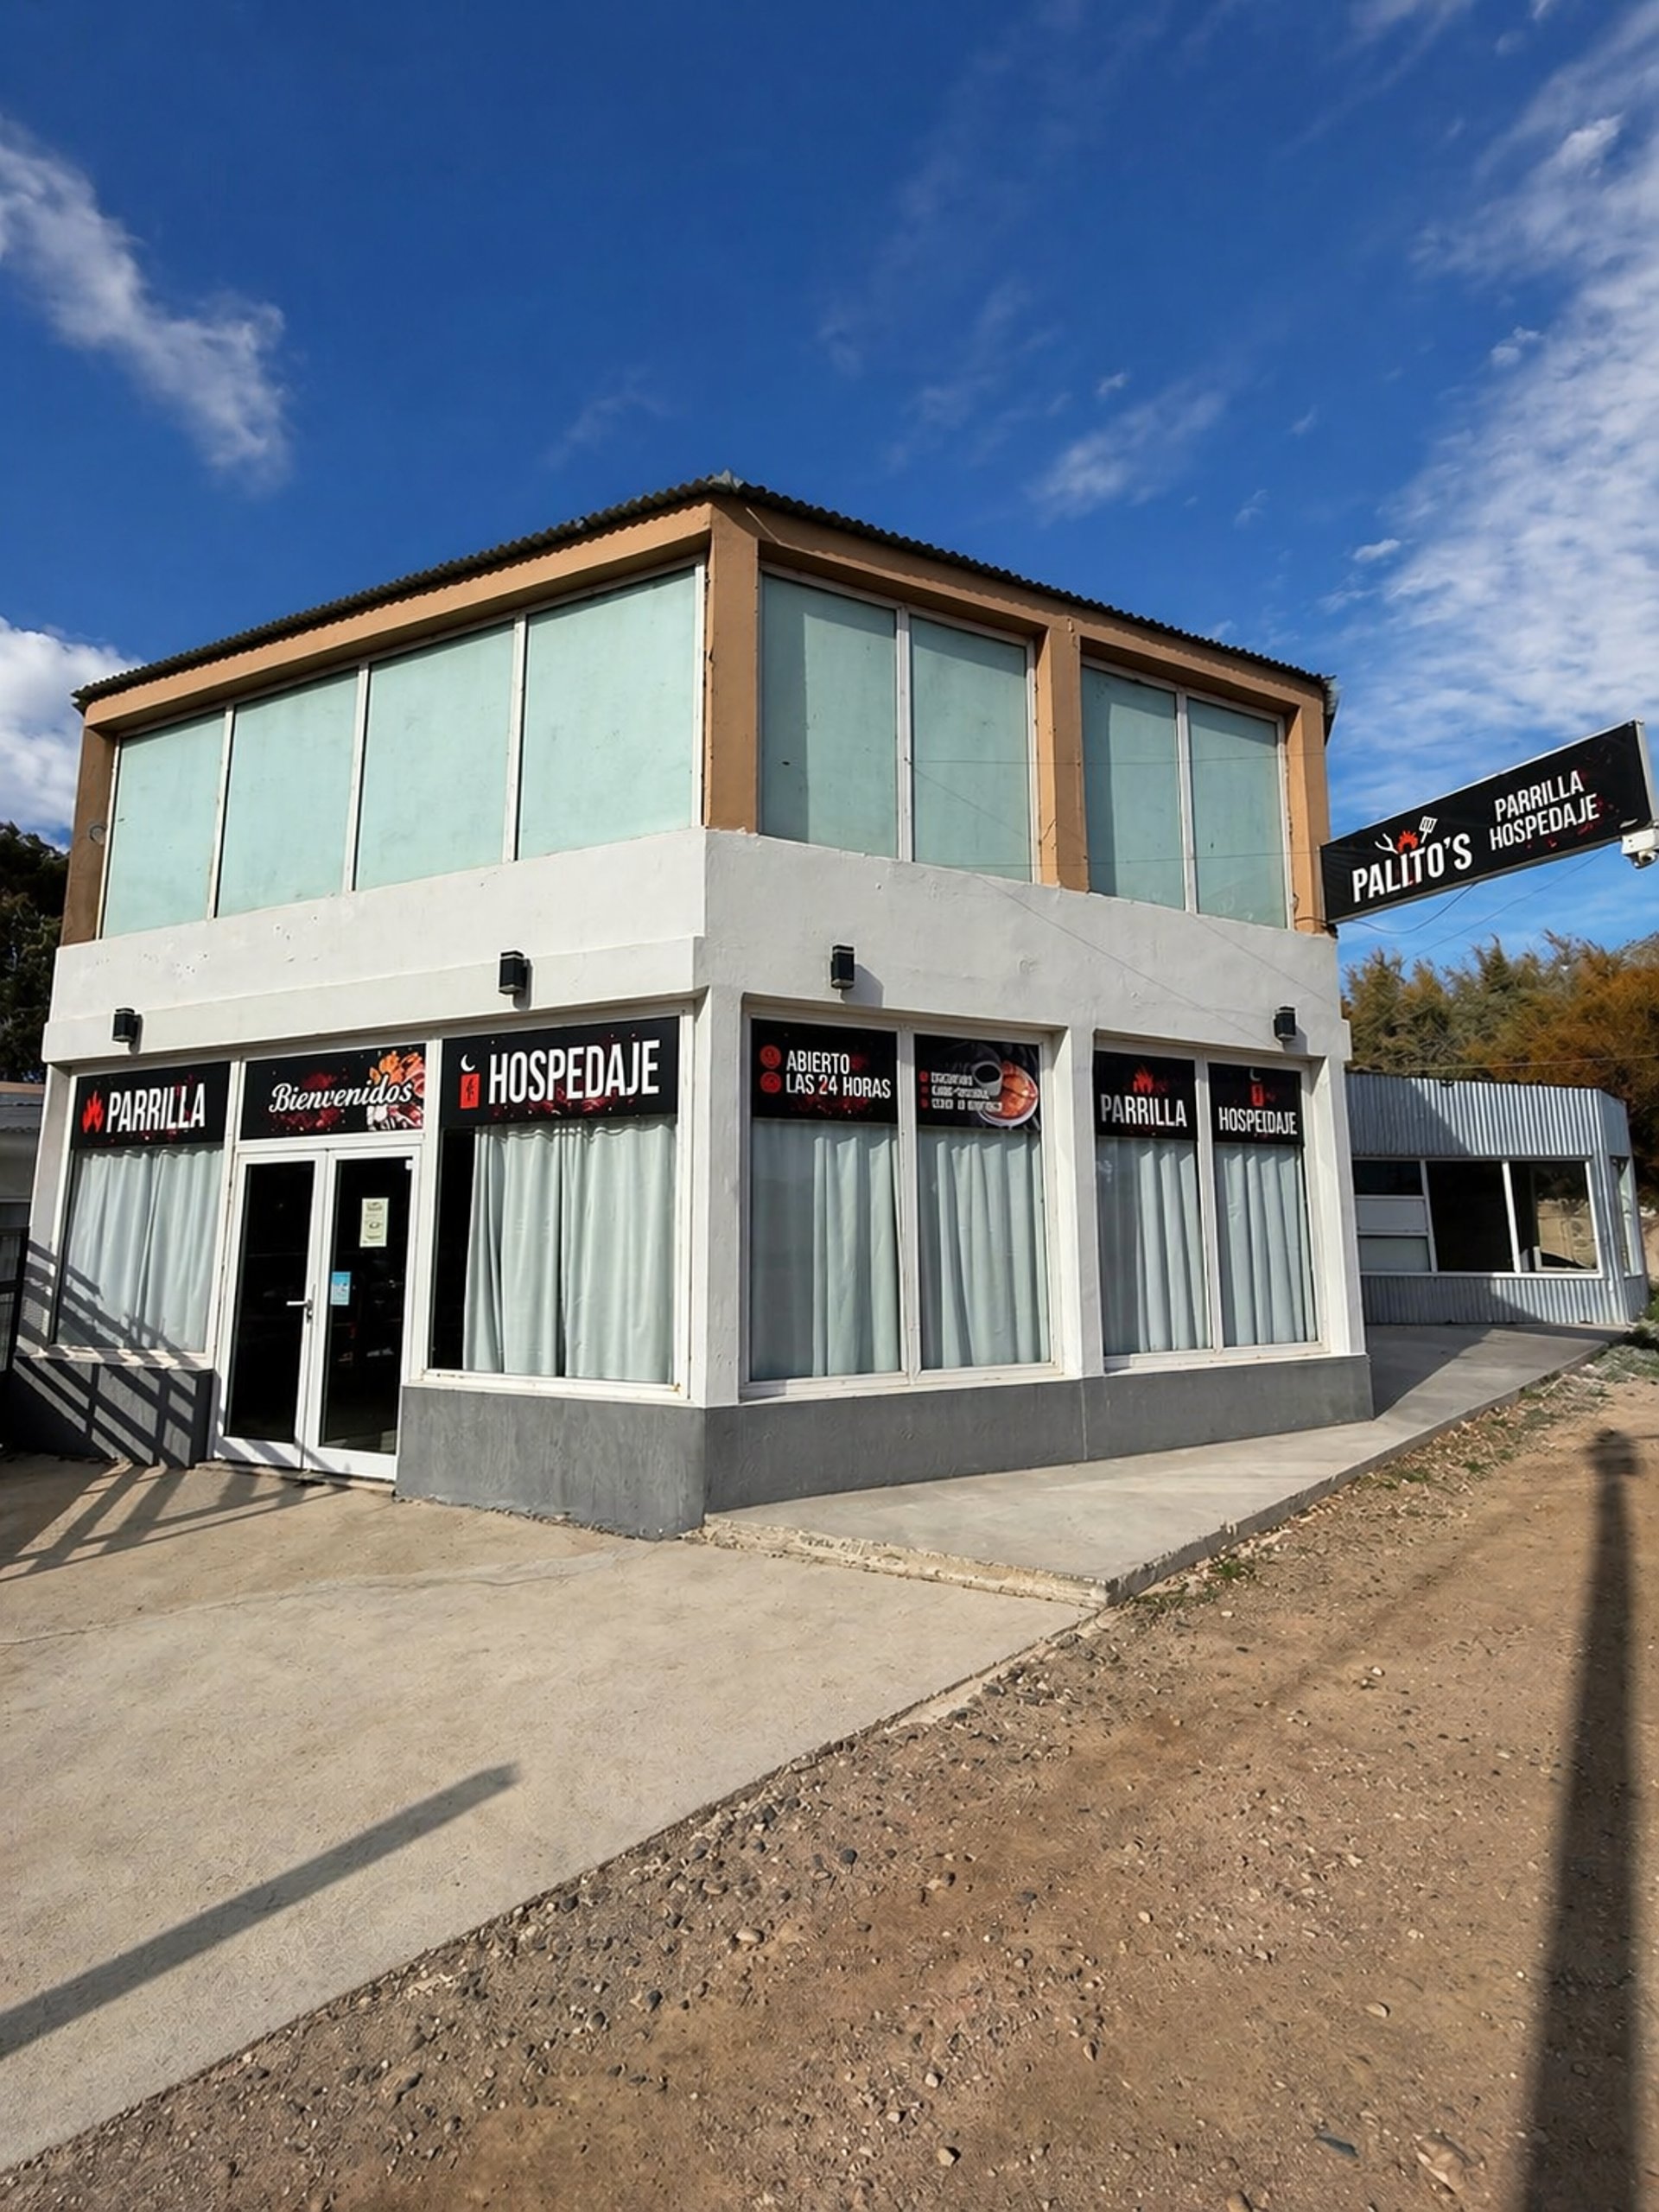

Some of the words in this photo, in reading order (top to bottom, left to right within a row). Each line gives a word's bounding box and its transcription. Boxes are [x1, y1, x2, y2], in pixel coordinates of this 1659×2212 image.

[1495, 770, 1585, 822] PARRILLA
[1489, 793, 1600, 850] HOSPEDAJE
[1351, 833, 1473, 903] PALITO'S
[488, 1039, 660, 1104] HOSPEDAJE
[785, 1073, 815, 1095] LAS
[818, 1074, 838, 1096] 24
[842, 1076, 892, 1099] HORAS
[786, 1050, 850, 1075] ABIERTO
[106, 1083, 206, 1133] PARRILLA
[269, 1074, 412, 1113] Bienvenidos
[1100, 1093, 1188, 1128] PARRILLA
